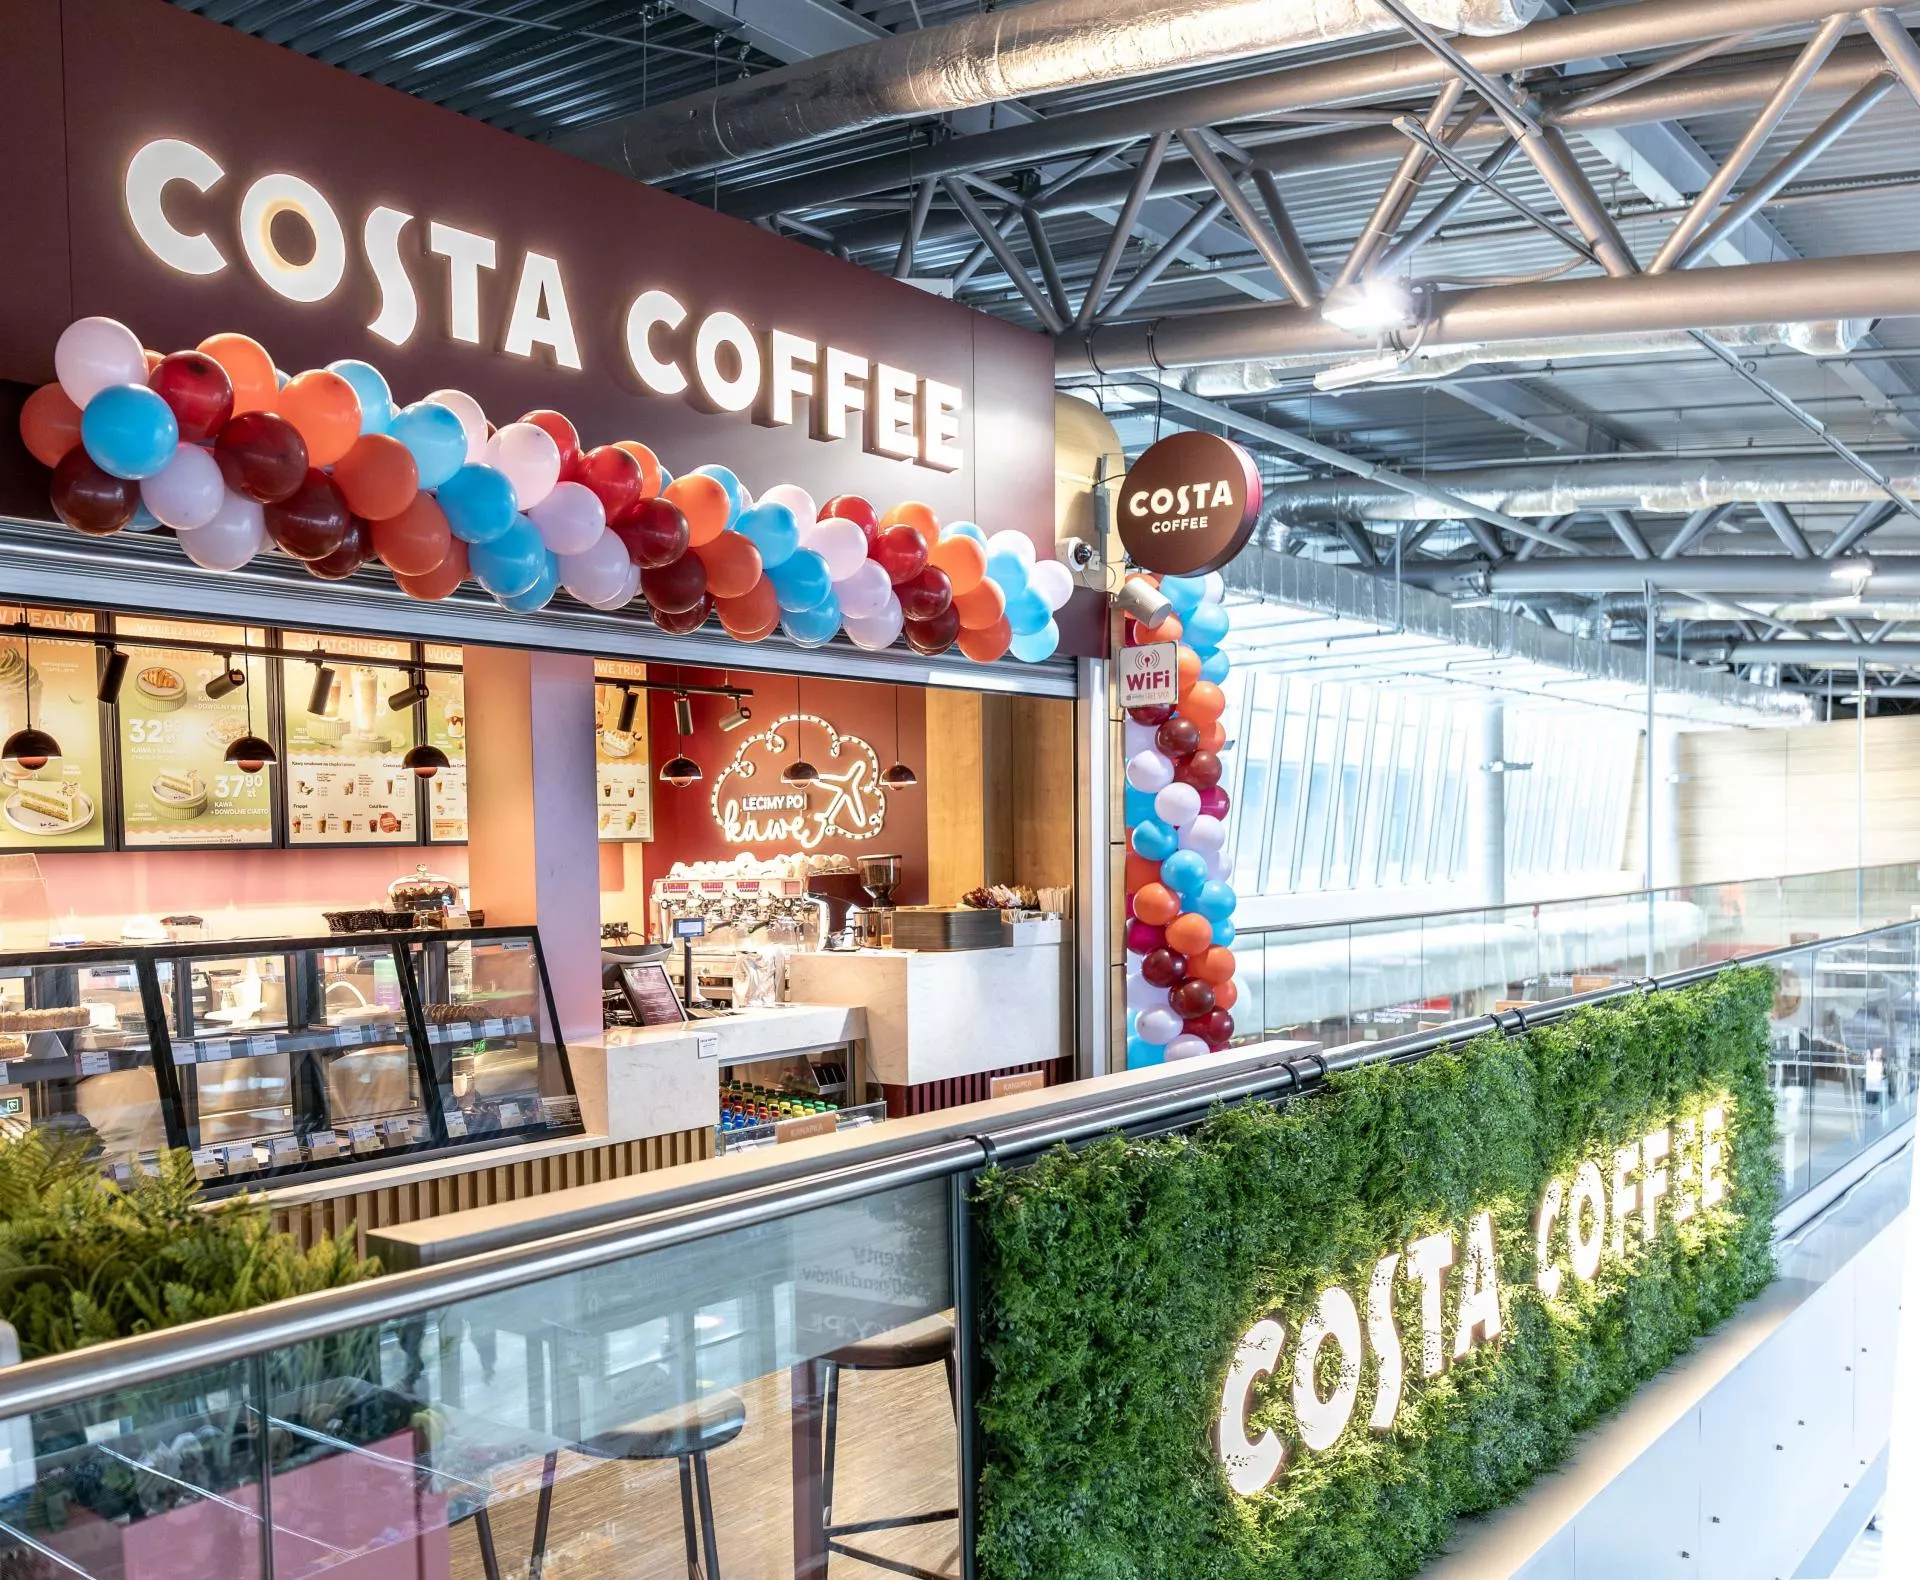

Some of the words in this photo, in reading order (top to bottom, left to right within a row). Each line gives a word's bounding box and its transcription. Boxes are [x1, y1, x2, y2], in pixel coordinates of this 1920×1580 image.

[125, 138, 582, 370] COSTA
[626, 289, 964, 470] COFFEE
[1129, 480, 1233, 517] COSTA
[1151, 516, 1208, 533] COFFEE
[299, 636, 397, 656] SMATCHNEGO
[616, 664, 641, 676] TRIO
[1126, 670, 1169, 691] WiFi
[214, 775, 243, 798] 37
[244, 775, 263, 787] 90
[743, 796, 785, 810] LECIMY
[786, 796, 804, 809] PO
[1218, 1210, 1504, 1496] COSTA
[1537, 1104, 1726, 1302] COFFEE
